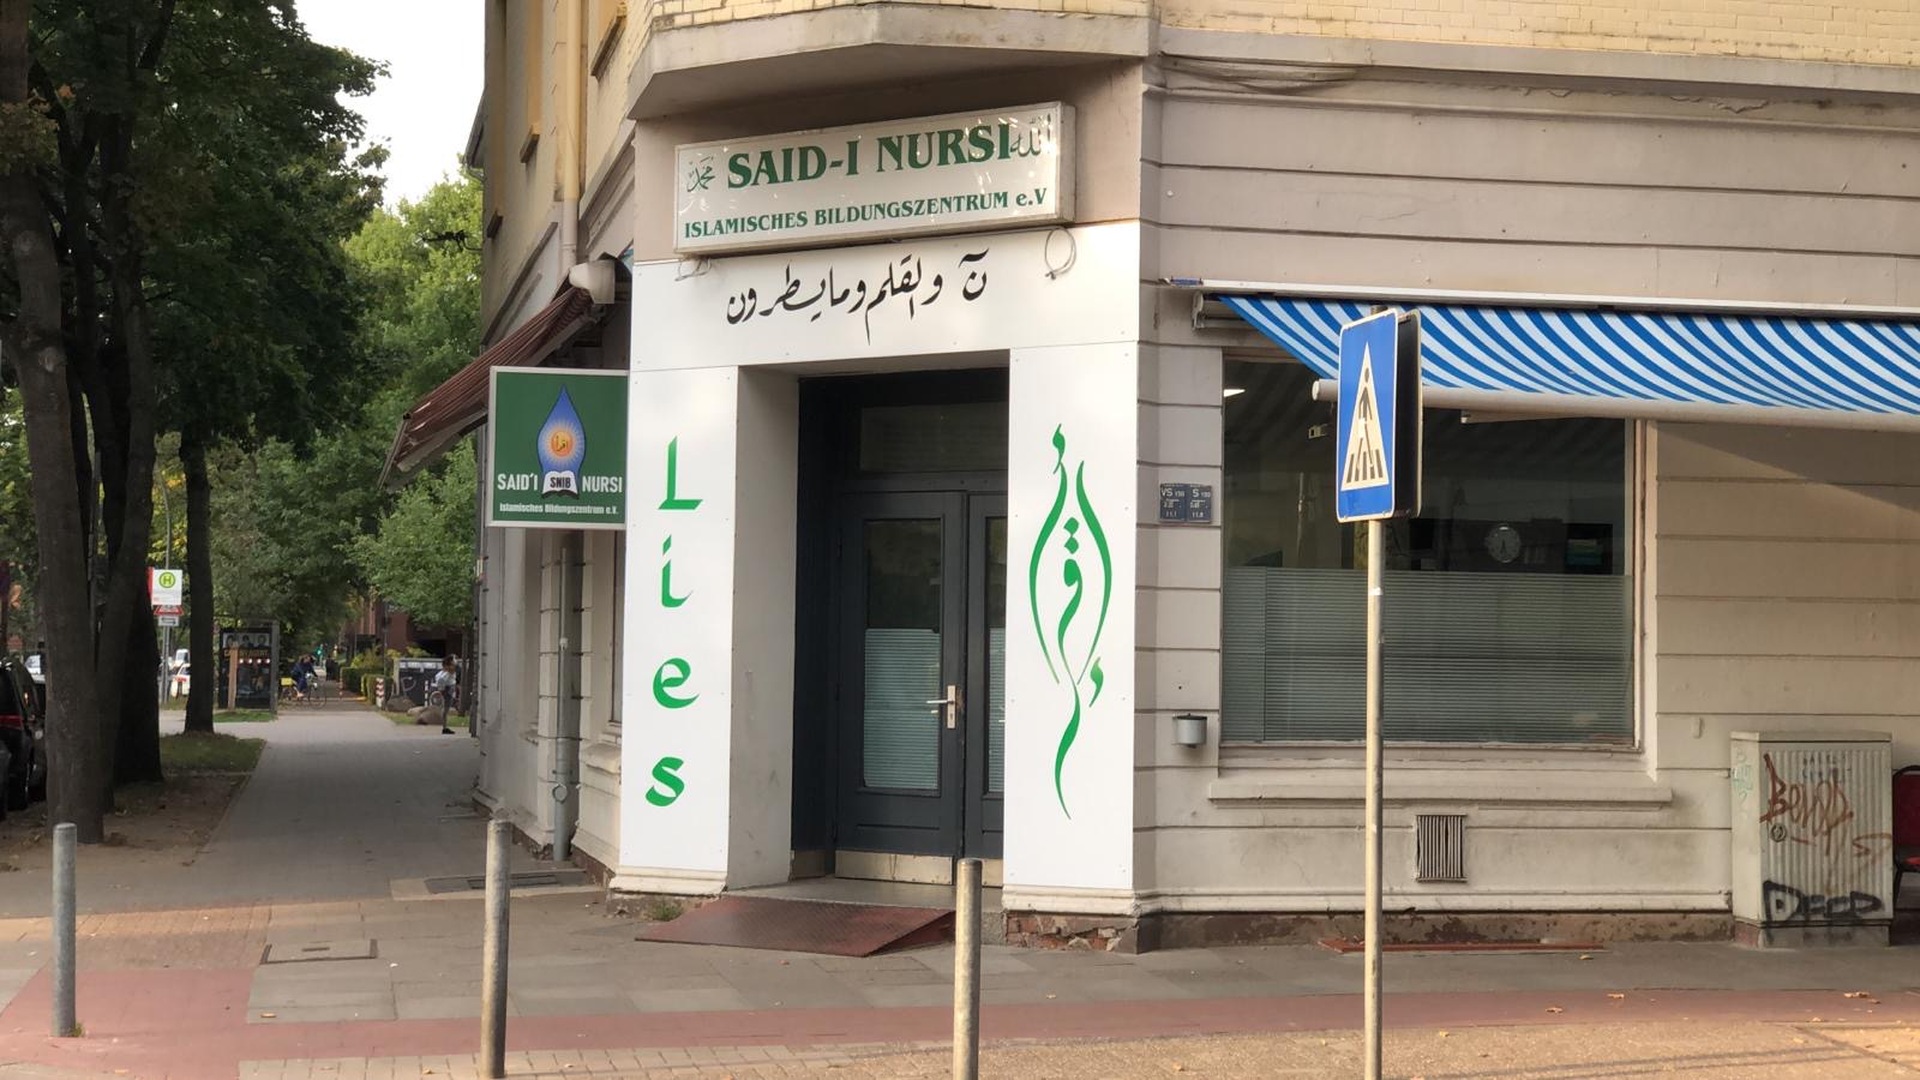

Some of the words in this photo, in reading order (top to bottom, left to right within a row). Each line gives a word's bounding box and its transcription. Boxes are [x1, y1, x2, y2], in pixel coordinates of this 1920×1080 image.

[876, 122, 1012, 173] NURSI
[684, 210, 809, 239] ISLAMISCHES
[814, 190, 1009, 227] BILDUNGSZENTRUM
[1015, 187, 1048, 208] e.V
[499, 502, 543, 514] Islamisches
[544, 503, 604, 515] Bildungszentrum
[549, 476, 571, 489] SNIB
[582, 475, 623, 494] NURSI
[644, 434, 704, 808] Lies
